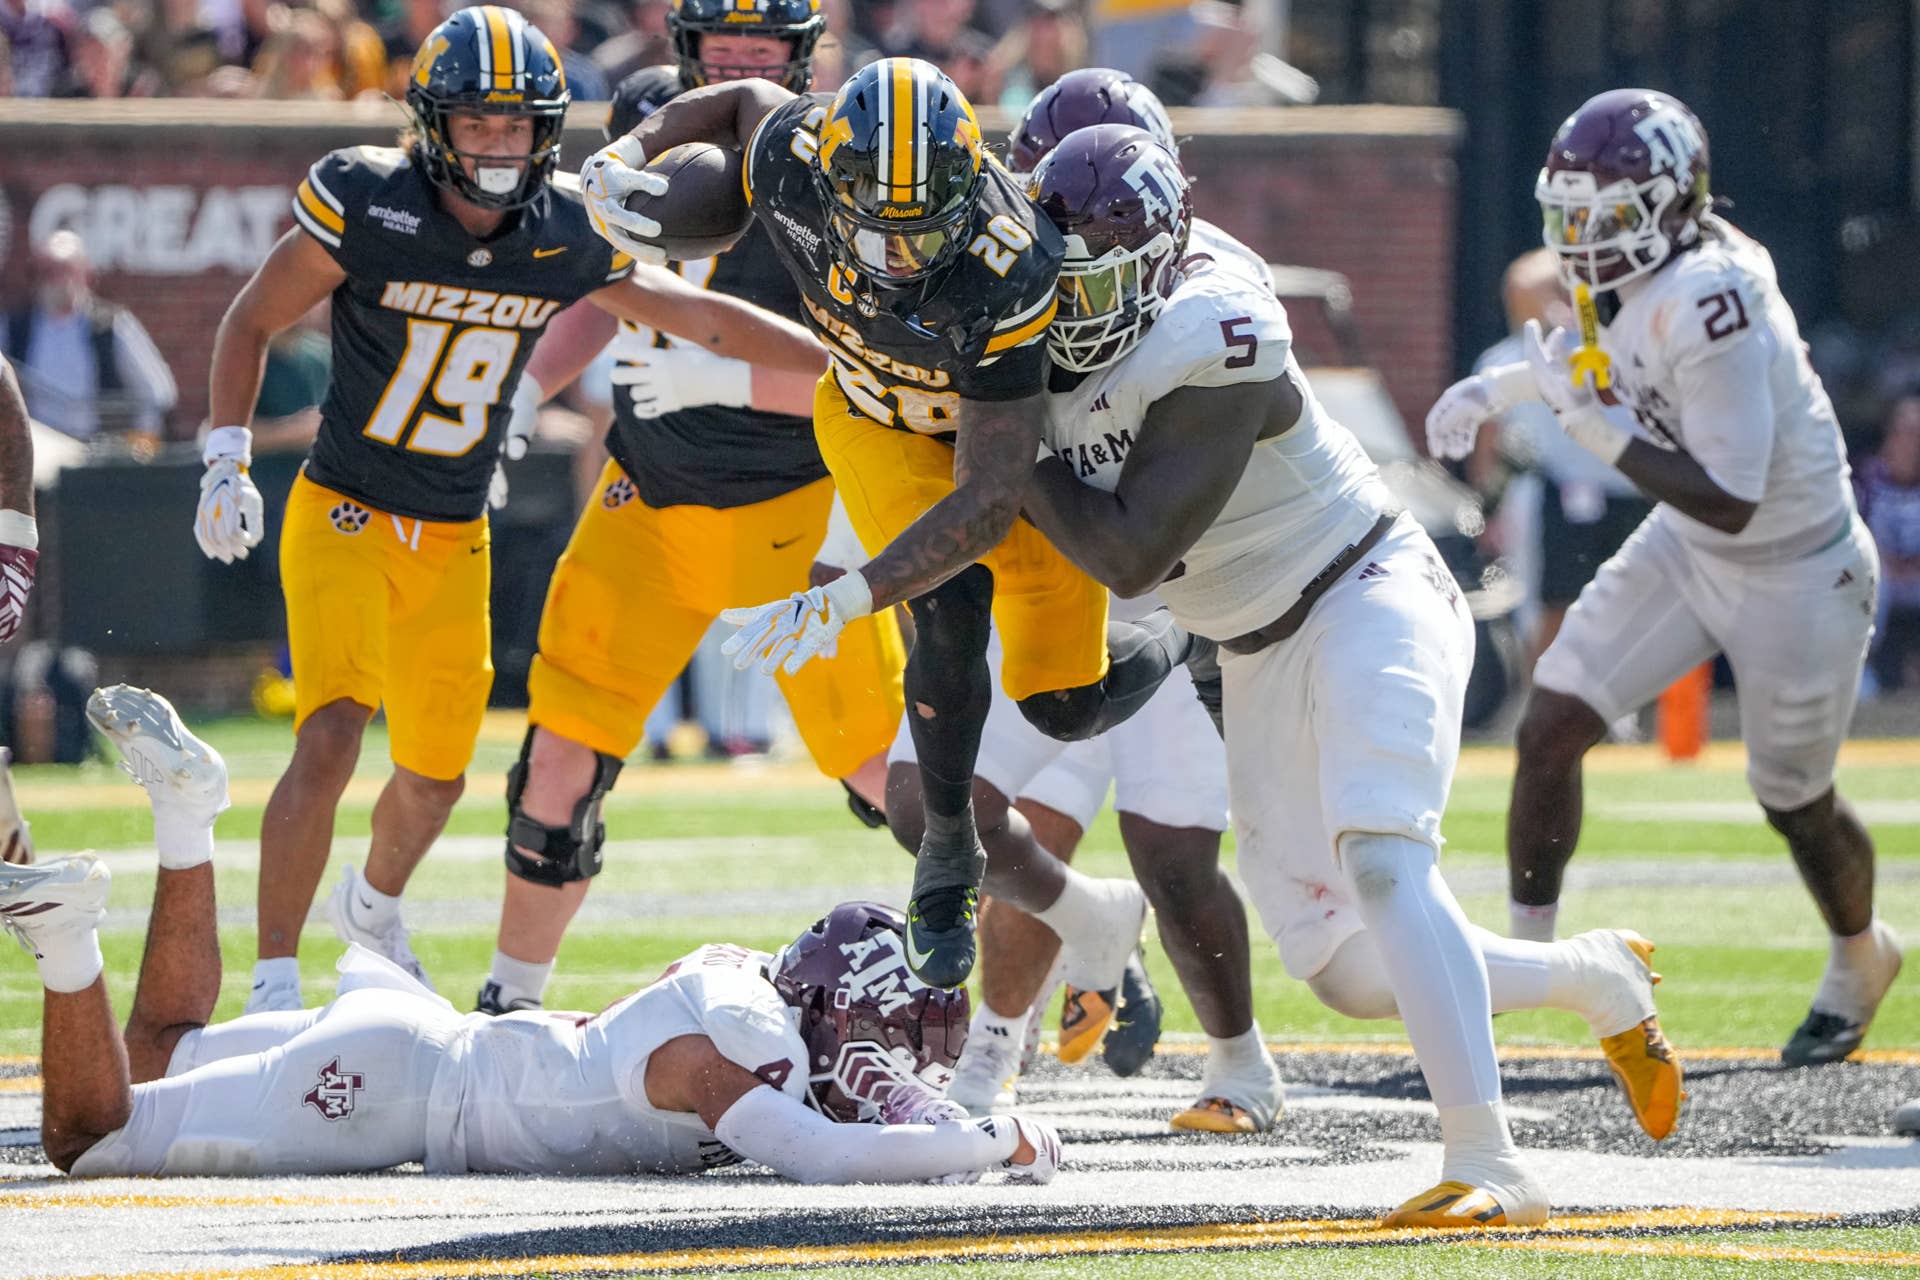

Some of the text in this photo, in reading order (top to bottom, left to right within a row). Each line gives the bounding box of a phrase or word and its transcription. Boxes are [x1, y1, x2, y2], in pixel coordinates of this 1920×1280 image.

[28, 183, 291, 276] GREAT
[368, 205, 422, 227] ambetter
[773, 210, 822, 247] ambetter
[879, 205, 924, 219] Missouri
[786, 228, 817, 254] HEALTH
[968, 214, 1033, 278] 20
[379, 281, 560, 329] MIZZOU
[827, 261, 858, 305] C
[1696, 289, 1749, 342] 21
[1219, 316, 1258, 369] 5
[362, 317, 521, 457] 19
